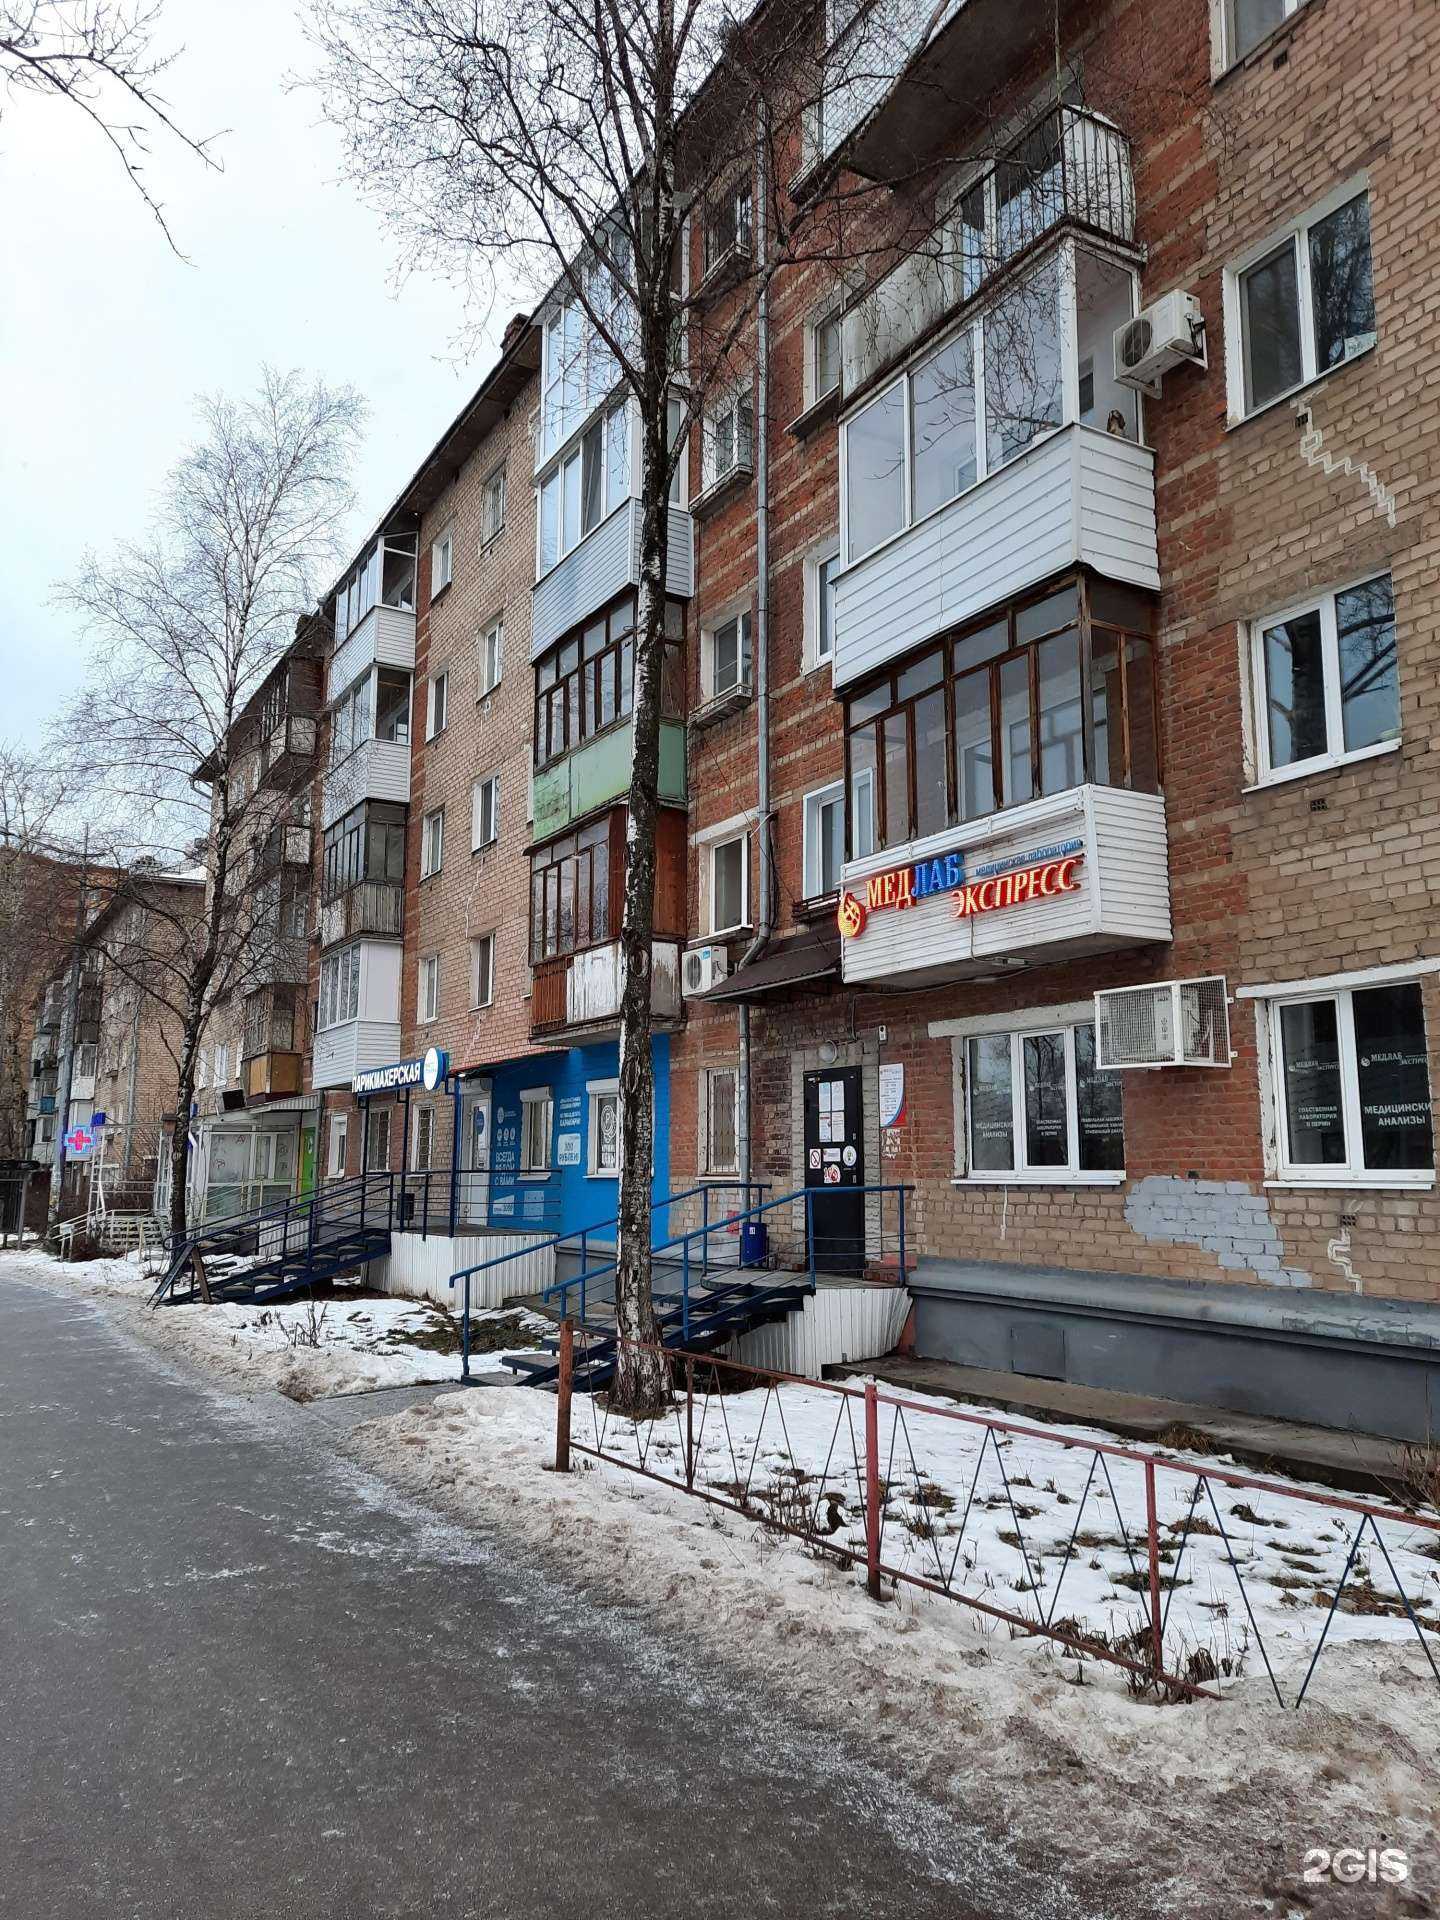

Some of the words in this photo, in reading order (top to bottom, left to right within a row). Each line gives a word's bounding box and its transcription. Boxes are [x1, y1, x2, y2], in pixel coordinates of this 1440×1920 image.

[864, 853, 965, 911] МЕДЛАБ
[950, 859, 1083, 918] ЭКСПРЕСС
[352, 1062, 420, 1093] ПАРИКМАХЕРСКАЯ
[1378, 1116, 1425, 1126] АНАЛИЗЫ
